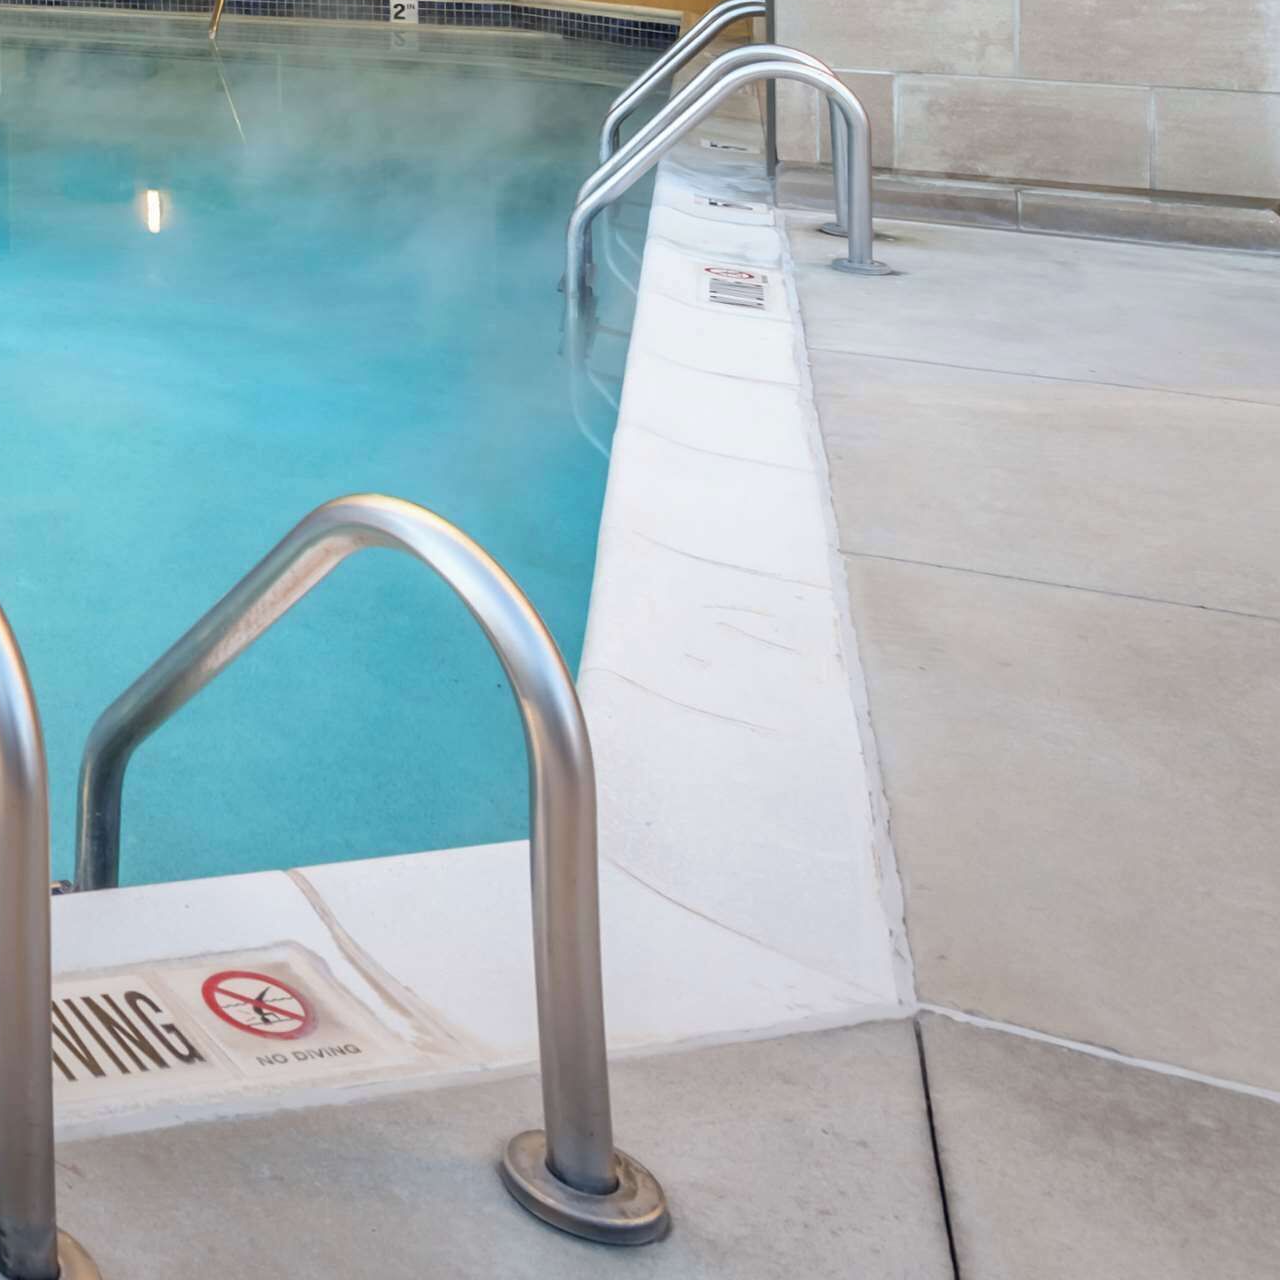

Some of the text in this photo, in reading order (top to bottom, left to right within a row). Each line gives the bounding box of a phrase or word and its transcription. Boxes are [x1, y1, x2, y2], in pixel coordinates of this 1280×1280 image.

[393, 3, 406, 20] 2
[256, 1044, 362, 1066] NO DIVING
